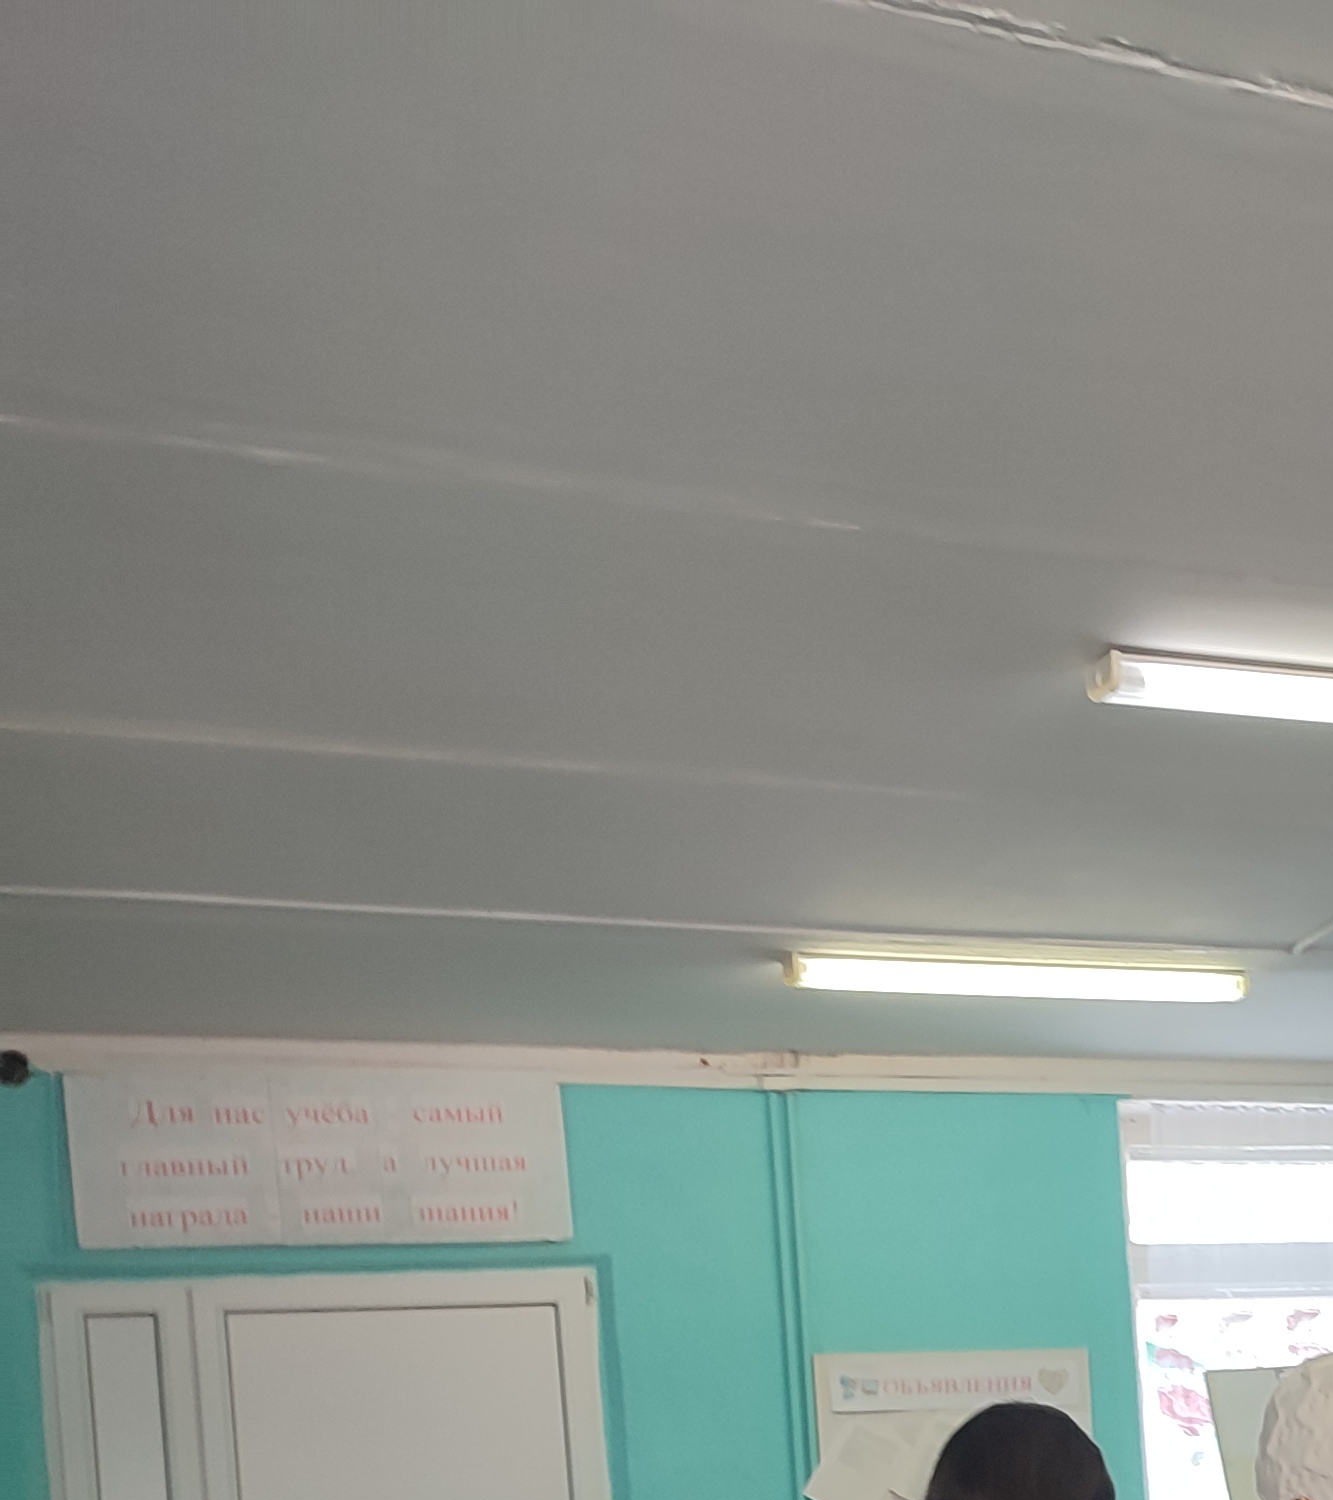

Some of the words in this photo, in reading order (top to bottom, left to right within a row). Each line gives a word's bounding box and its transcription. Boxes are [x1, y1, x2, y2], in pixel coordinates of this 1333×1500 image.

[132, 1100, 194, 1128] Для
[214, 1107, 264, 1125] нас
[413, 1102, 504, 1125] самый
[383, 1156, 397, 1173] а
[426, 1156, 526, 1178] лучшая
[131, 1208, 248, 1234] награда
[304, 1206, 382, 1224] наши
[882, 1375, 1033, 1395] ОБЪЯВЛЕНИЯ
